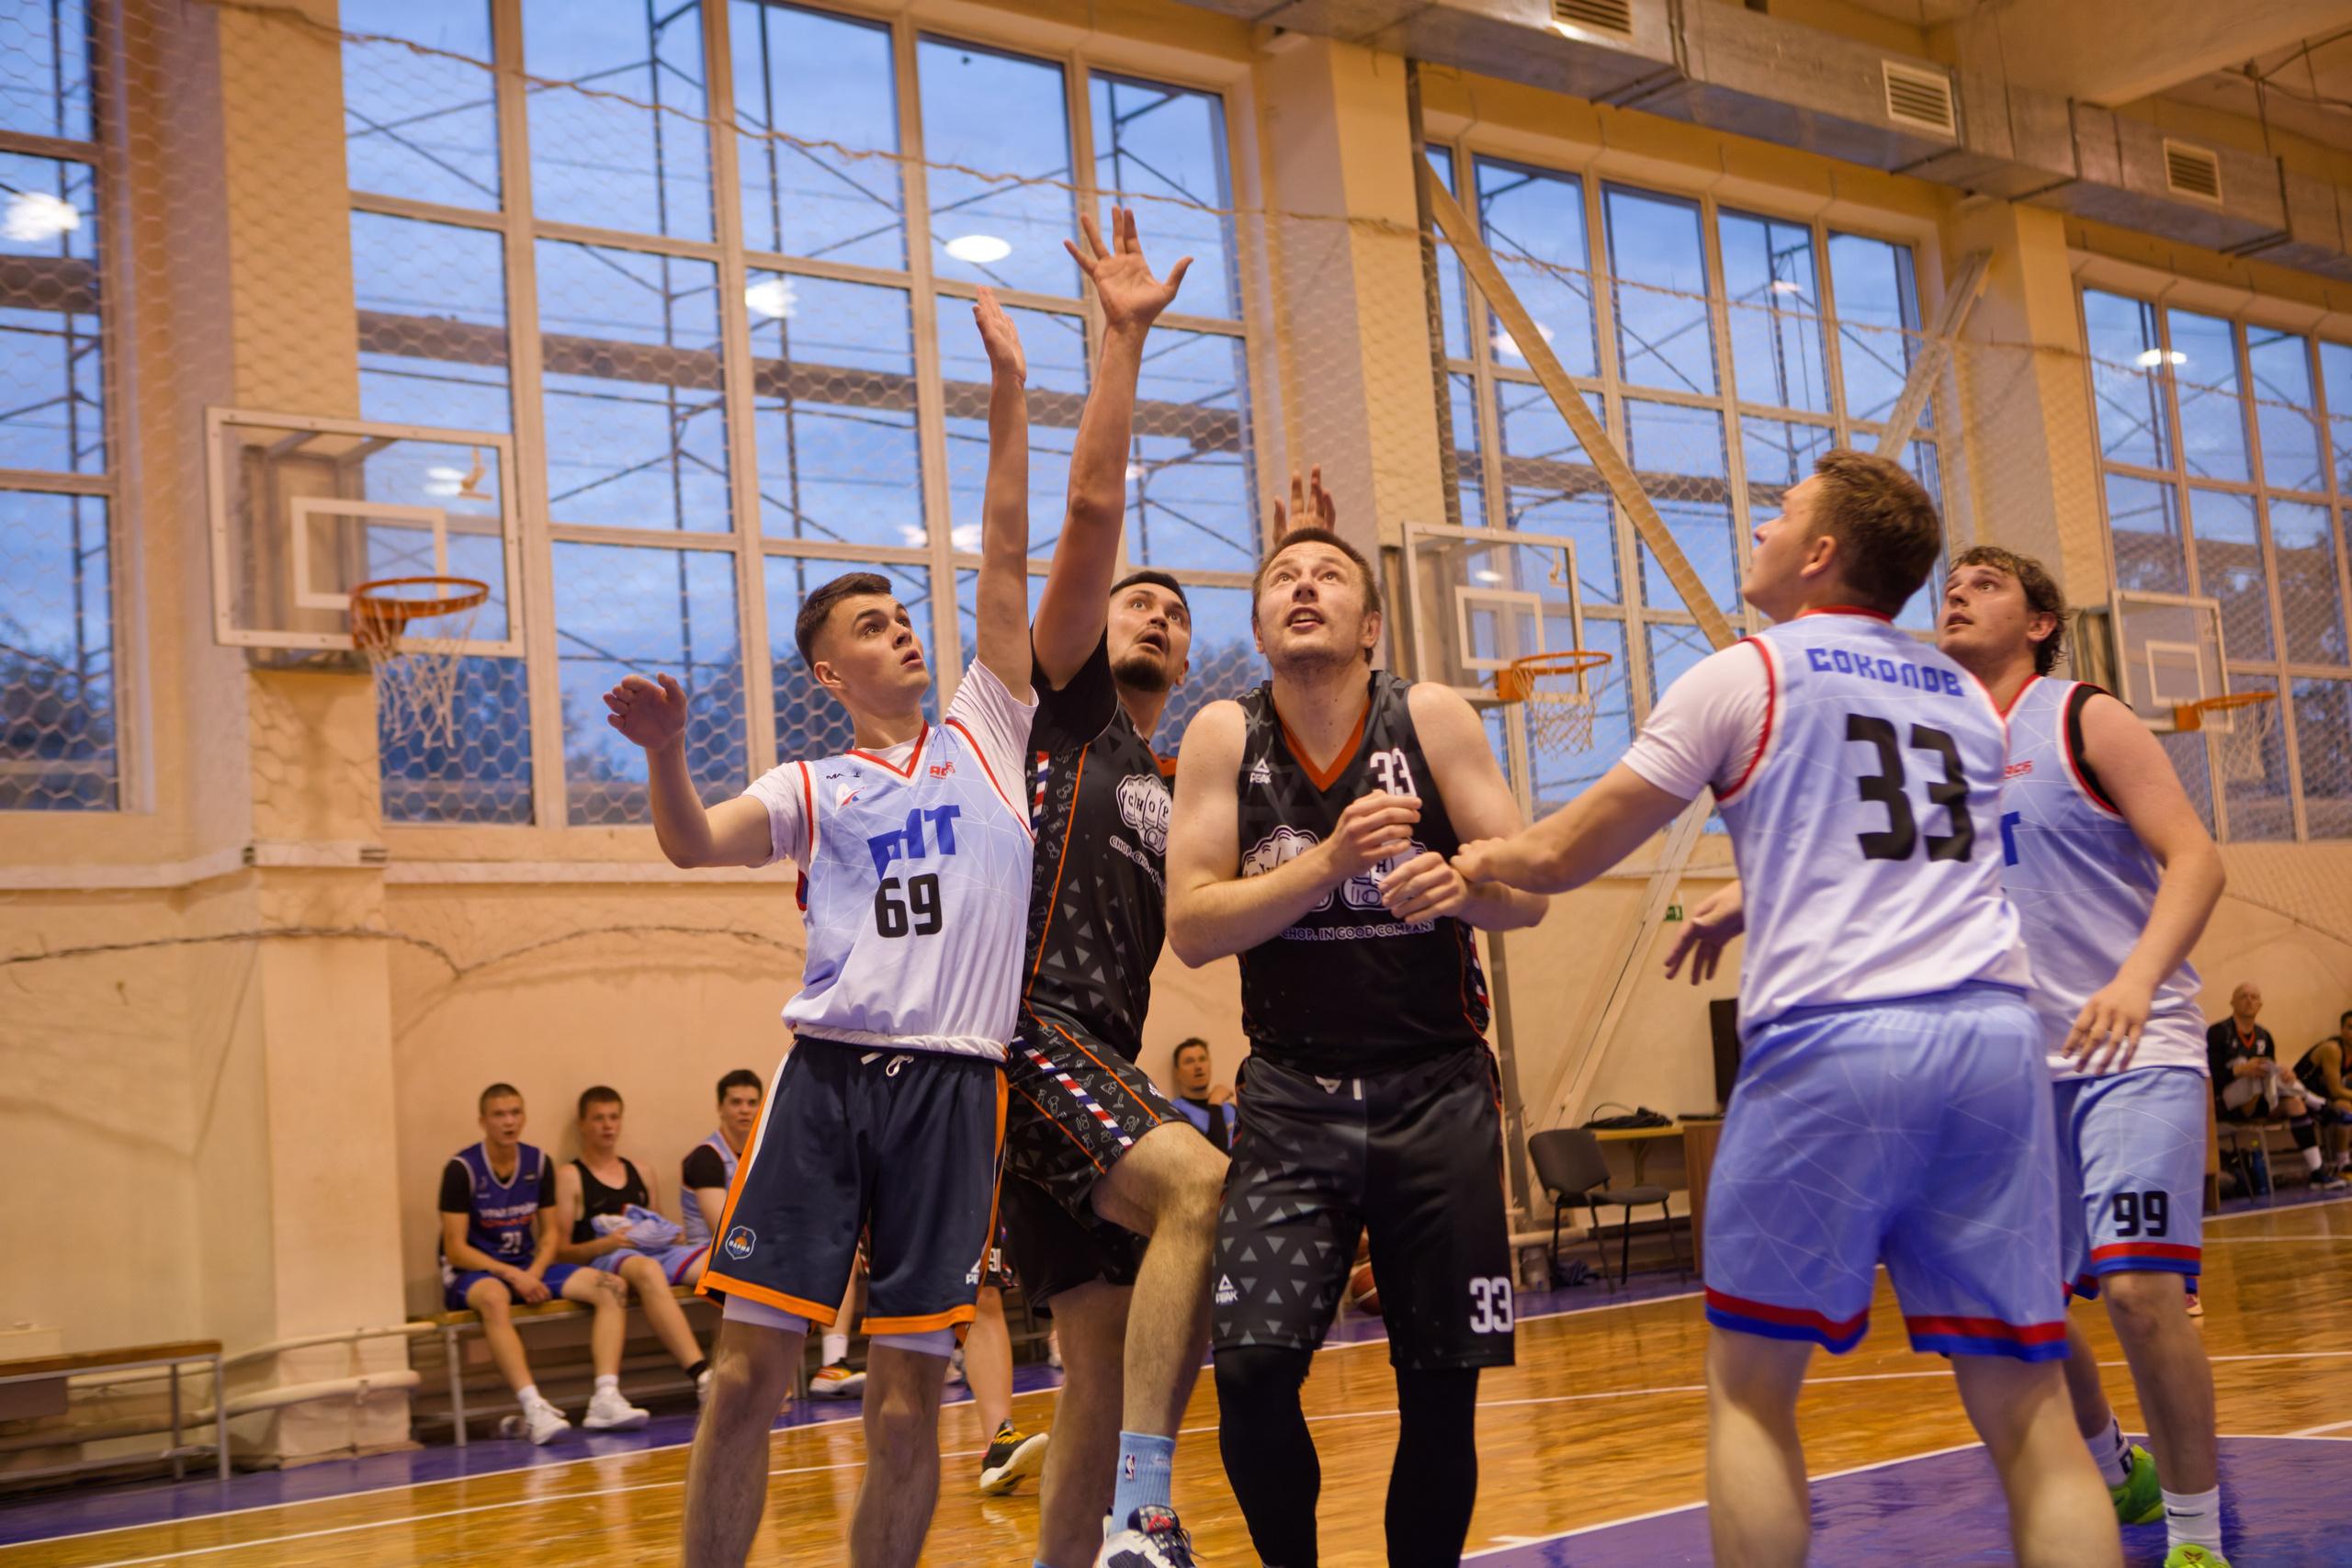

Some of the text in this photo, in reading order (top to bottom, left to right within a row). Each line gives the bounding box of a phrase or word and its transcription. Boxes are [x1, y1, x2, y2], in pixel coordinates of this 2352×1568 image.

[1805, 648, 1964, 697] СОКОЛОВ
[1250, 773, 1272, 784] PEAK
[1370, 748, 1418, 797] 33
[1846, 713, 1974, 863] 33
[1128, 794, 1170, 818] CHOP
[875, 873, 943, 938] 69
[1318, 927, 1335, 941] IN
[1335, 925, 1375, 940] GOOD
[2113, 1190, 2168, 1237] 99
[1469, 1276, 1513, 1334] 33
